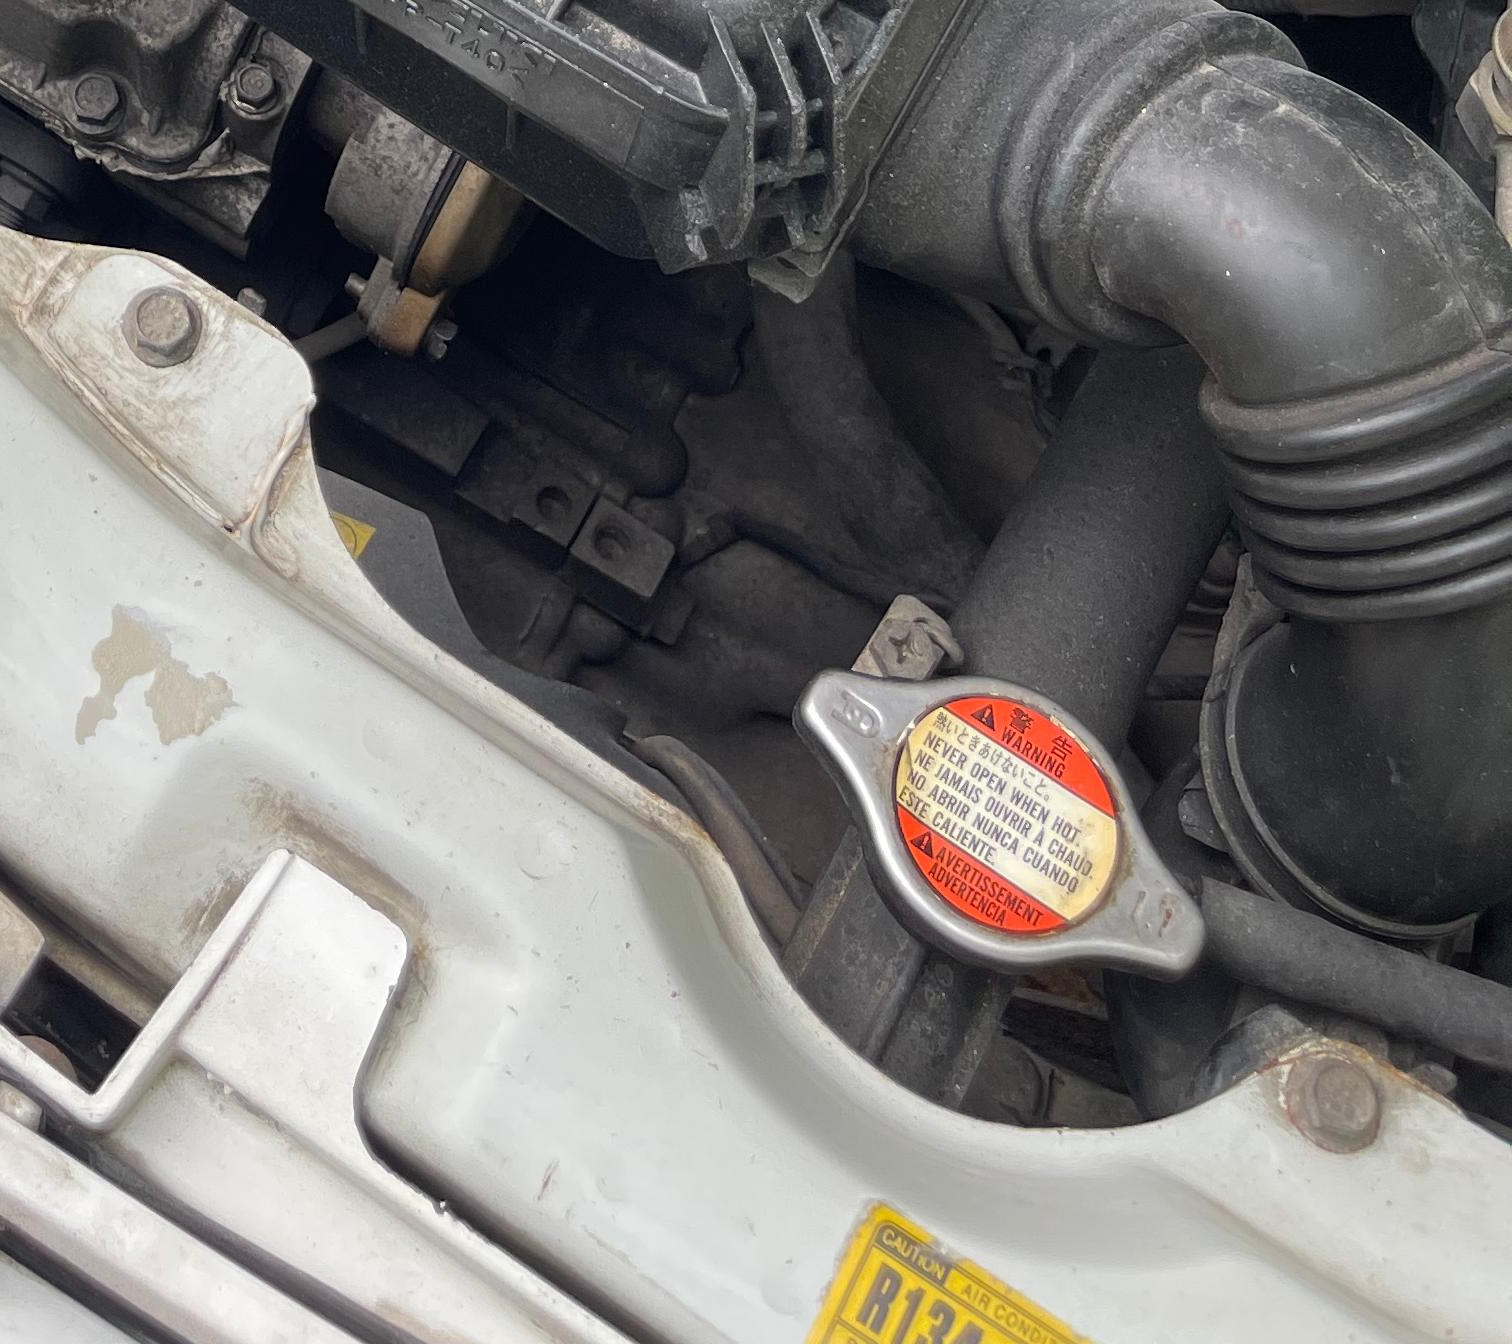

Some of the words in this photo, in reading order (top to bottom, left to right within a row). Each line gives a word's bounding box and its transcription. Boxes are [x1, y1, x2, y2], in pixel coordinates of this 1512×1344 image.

[914, 748, 935, 772] NE
[934, 763, 983, 804] JAMAIS
[984, 796, 1033, 838] OUVRIR
[923, 730, 968, 770] NEVER
[970, 762, 1007, 795] OPEN
[1009, 786, 1051, 825] WHEN
[1001, 726, 1066, 779] WARNING
[898, 784, 931, 819] ESTE
[906, 769, 927, 791] NO
[927, 784, 970, 822] ABRIR
[972, 812, 1020, 855] NUNCA
[1022, 846, 1079, 894] CUANDO
[928, 862, 1007, 926] ADVERTENCIA
[935, 846, 1044, 927] AVERTISSEMENT
[882, 1227, 946, 1281] CAUTION
[961, 1283, 991, 1311] AIR
